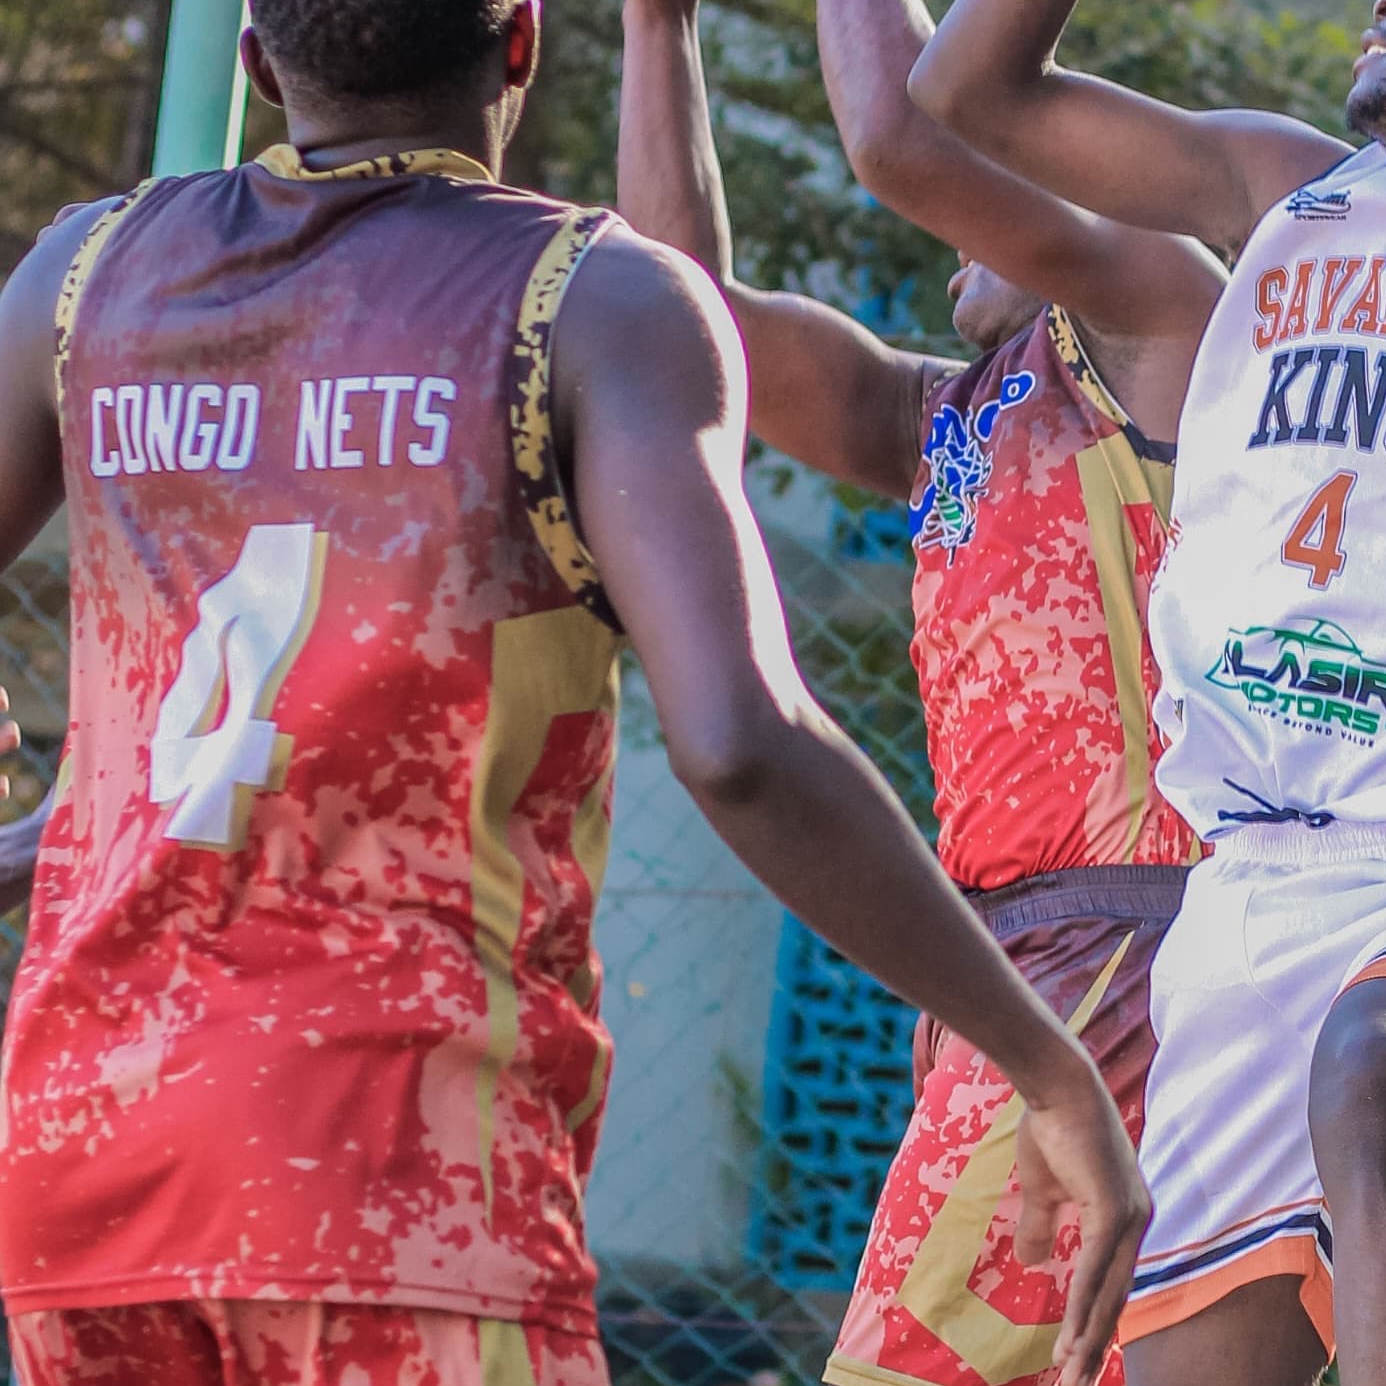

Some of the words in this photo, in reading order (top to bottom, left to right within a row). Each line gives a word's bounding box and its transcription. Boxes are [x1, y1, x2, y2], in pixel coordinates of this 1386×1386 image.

[89, 383, 261, 477] CONGO
[293, 375, 458, 471] NETS
[1280, 468, 1358, 591] 4
[149, 523, 328, 849] 4
